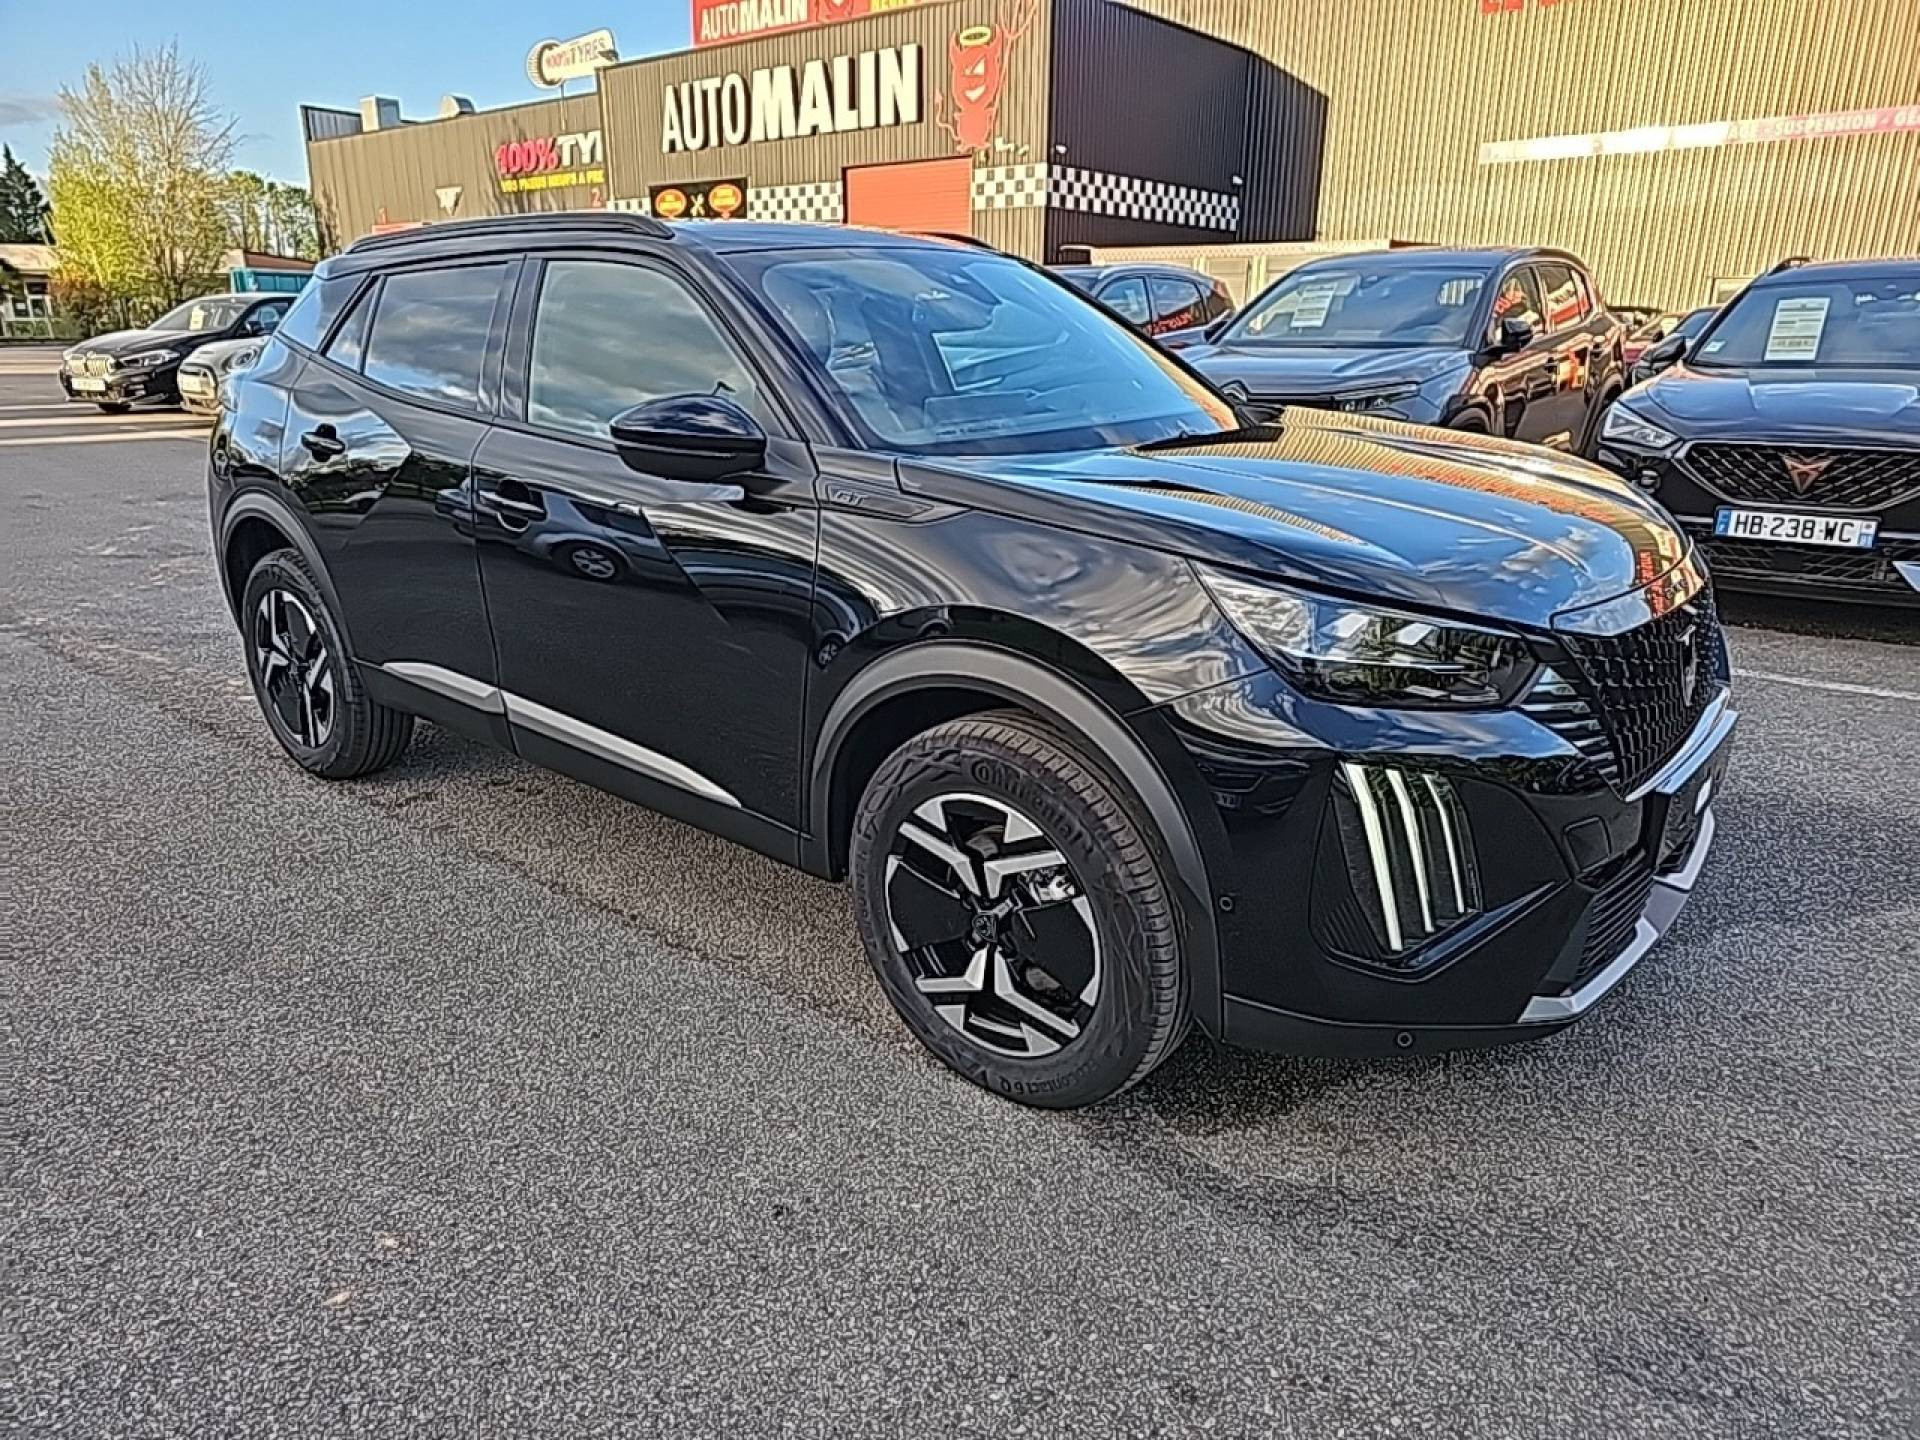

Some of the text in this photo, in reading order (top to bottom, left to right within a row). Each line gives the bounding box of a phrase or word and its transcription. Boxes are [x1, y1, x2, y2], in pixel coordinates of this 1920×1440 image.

[701, 0, 808, 41] AUTOMALIN
[662, 43, 924, 154] AUTOMALIN
[1775, 111, 1876, 136] SUSPENSION
[1733, 513, 1854, 544] HB-238-WC
